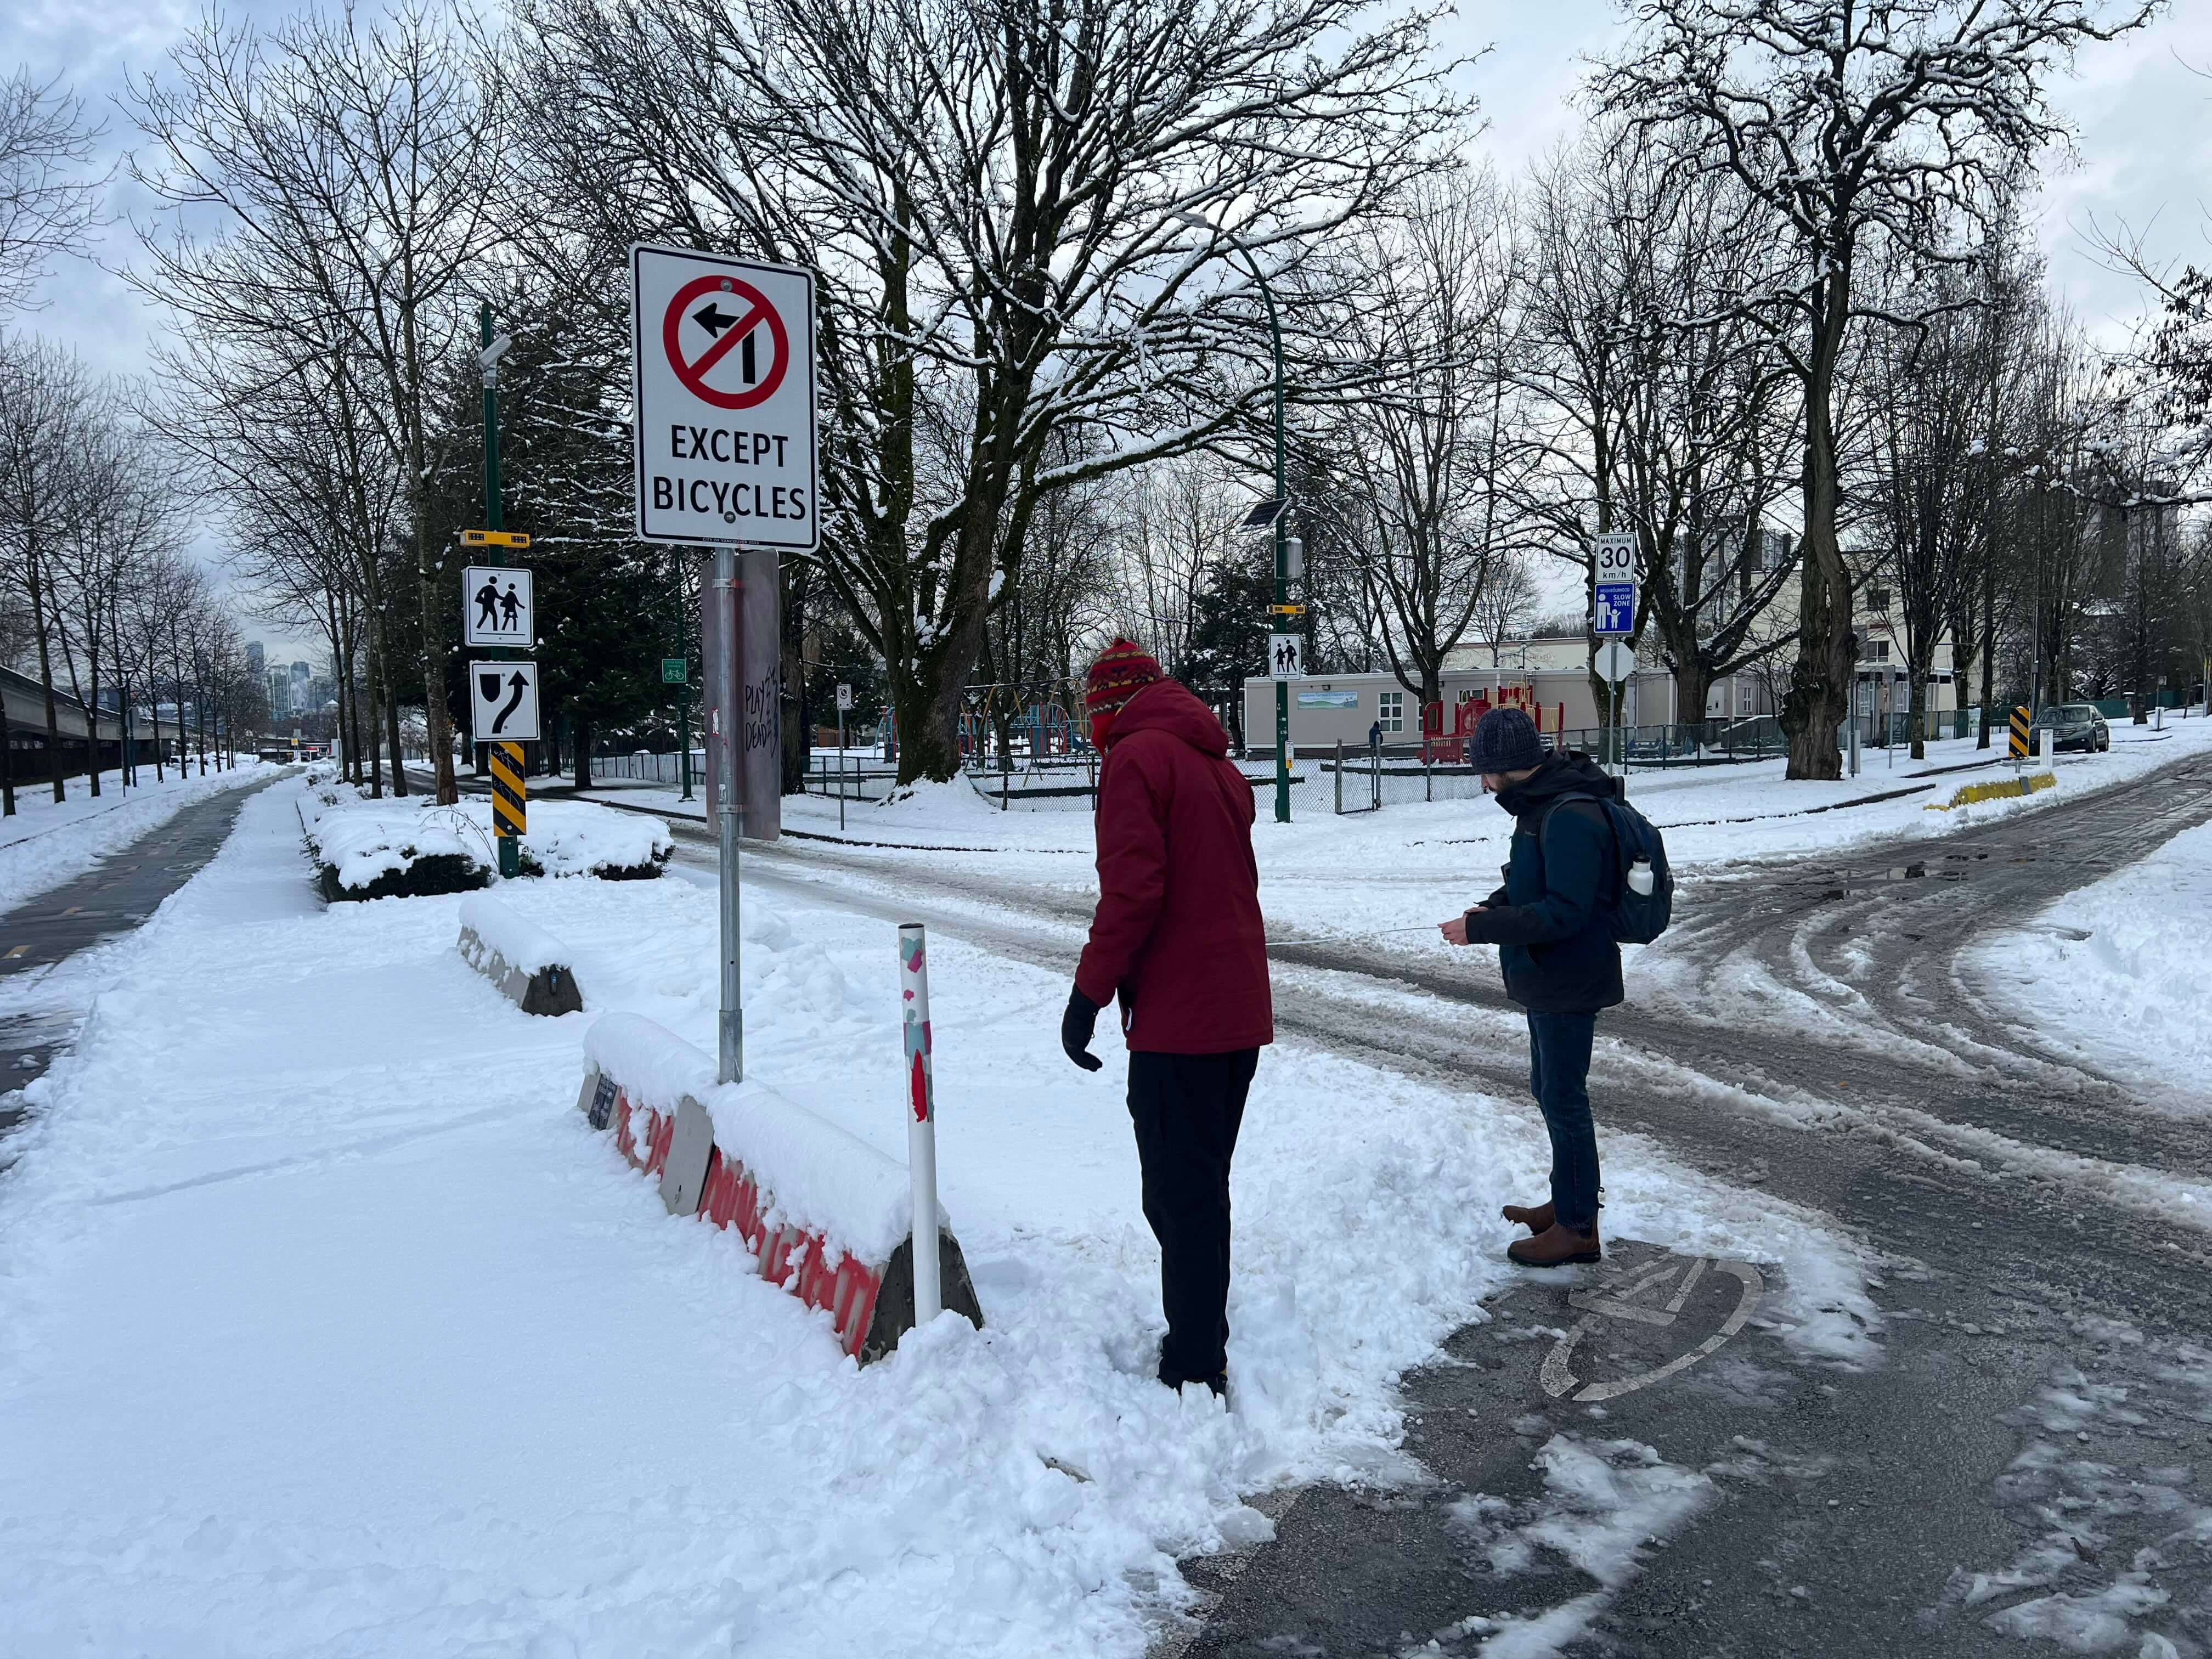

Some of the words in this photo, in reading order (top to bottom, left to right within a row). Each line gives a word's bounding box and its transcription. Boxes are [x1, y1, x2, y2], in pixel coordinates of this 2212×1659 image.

[672, 424, 788, 467] EXCEPT
[653, 476, 805, 520] BICYCLES
[1600, 546, 1630, 568] 30
[1603, 571, 1626, 579] km/h
[746, 680, 764, 723] PLAY
[746, 721, 767, 752] DEAD
